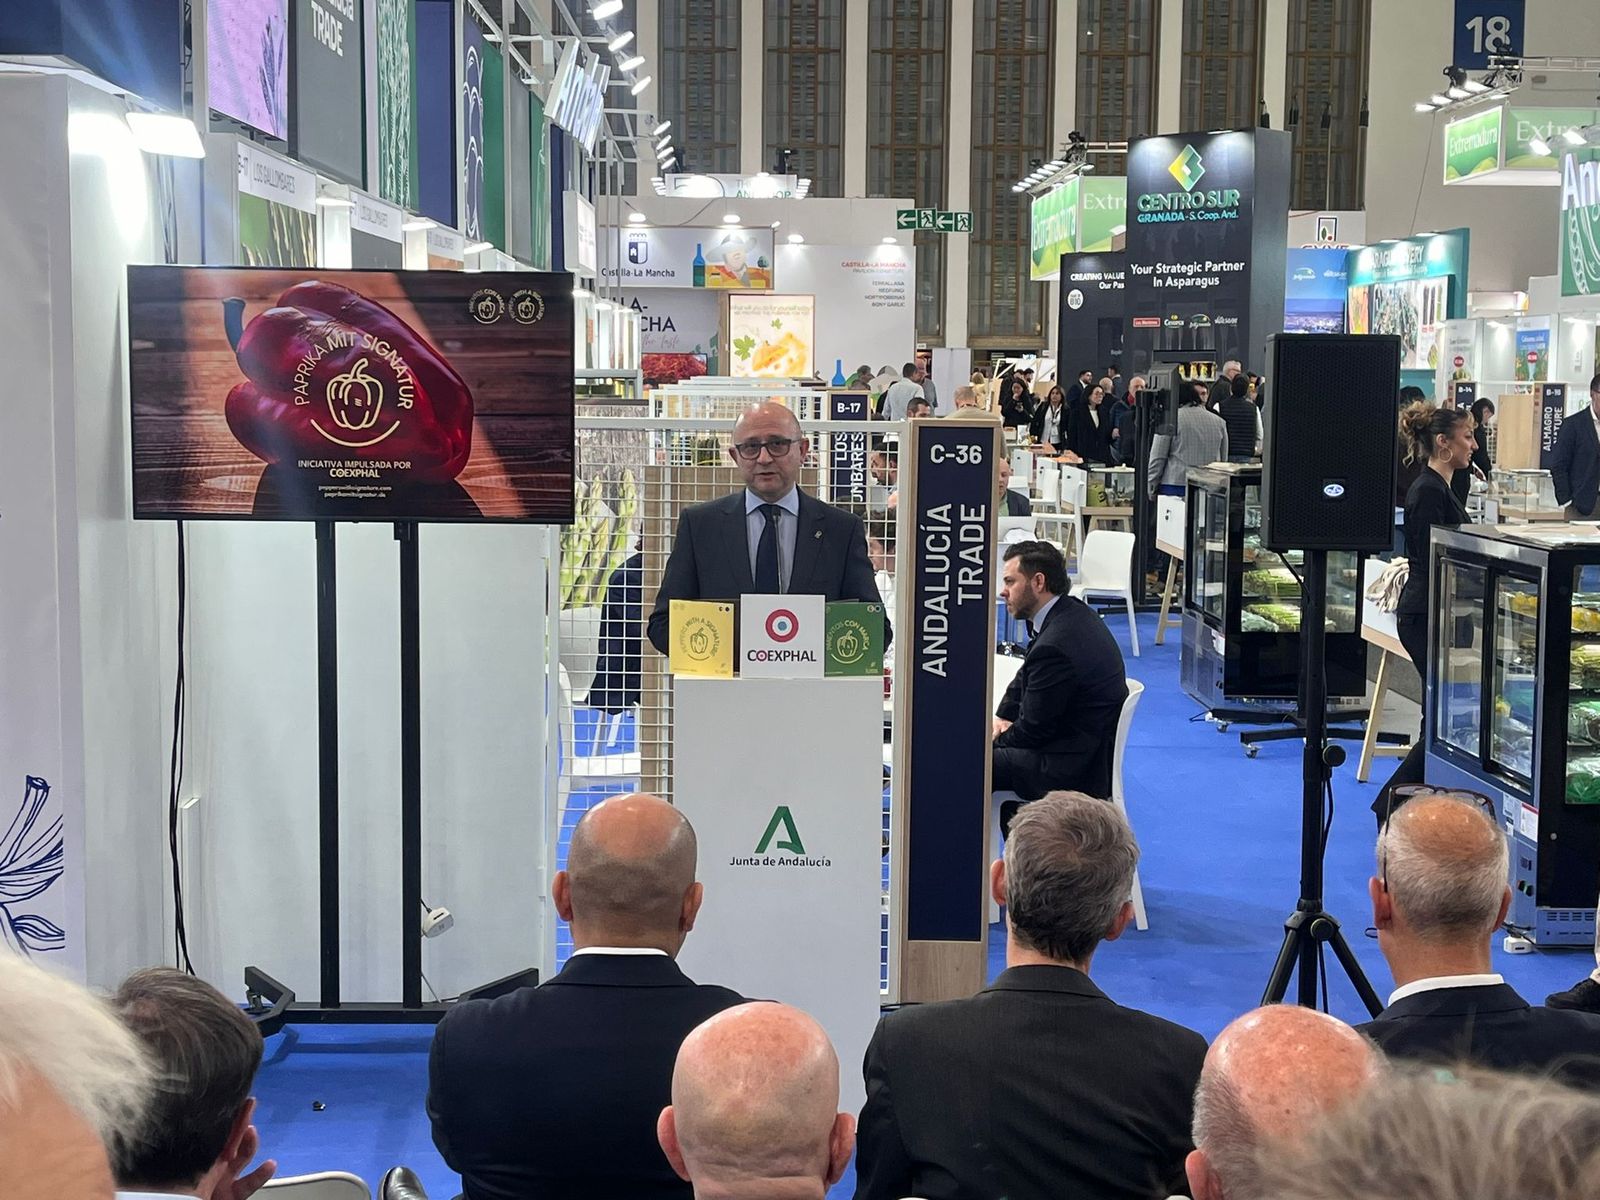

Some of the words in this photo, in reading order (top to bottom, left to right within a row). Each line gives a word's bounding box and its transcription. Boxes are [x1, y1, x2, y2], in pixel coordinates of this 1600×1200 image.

[311, 0, 343, 57] TRADE
[1466, 16, 1511, 53] 18
[1450, 127, 1498, 157] Extremadura
[1083, 193, 1128, 210] Extr
[1137, 191, 1205, 212] CENTRO
[1206, 189, 1240, 209] SUR
[1137, 212, 1185, 223] GRANADA
[645, 269, 676, 278] Mancha
[1130, 264, 1154, 275] Your
[1155, 261, 1203, 275] Strategic
[1205, 261, 1245, 272] Partner
[1070, 273, 1103, 281] CREATING
[1103, 272, 1125, 280] VALUE
[1153, 277, 1163, 287] In
[1165, 276, 1220, 290] Asparagus
[1099, 281, 1111, 289] Our
[641, 316, 676, 332] CHA
[294, 344, 329, 406] PAPRIKA
[326, 332, 357, 351] MIT
[361, 333, 414, 410] SIGNATUR
[837, 402, 861, 413] B-17
[1543, 406, 1553, 452] ALMAGRO
[835, 431, 848, 461] LOS
[930, 444, 982, 464] C-36
[298, 460, 343, 469] INICIATIVA
[344, 460, 392, 469] IMPULSADA
[393, 461, 412, 470] POR
[329, 468, 381, 478] COEXPHAL
[957, 504, 986, 606] TRADE
[920, 502, 952, 678] ANDALUCÍA
[844, 619, 860, 629] CON
[859, 626, 870, 651] MARCA
[747, 649, 817, 663] COEXPHAL
[729, 856, 760, 867] Junta
[762, 856, 776, 867] de
[778, 856, 831, 868] Andalucía
